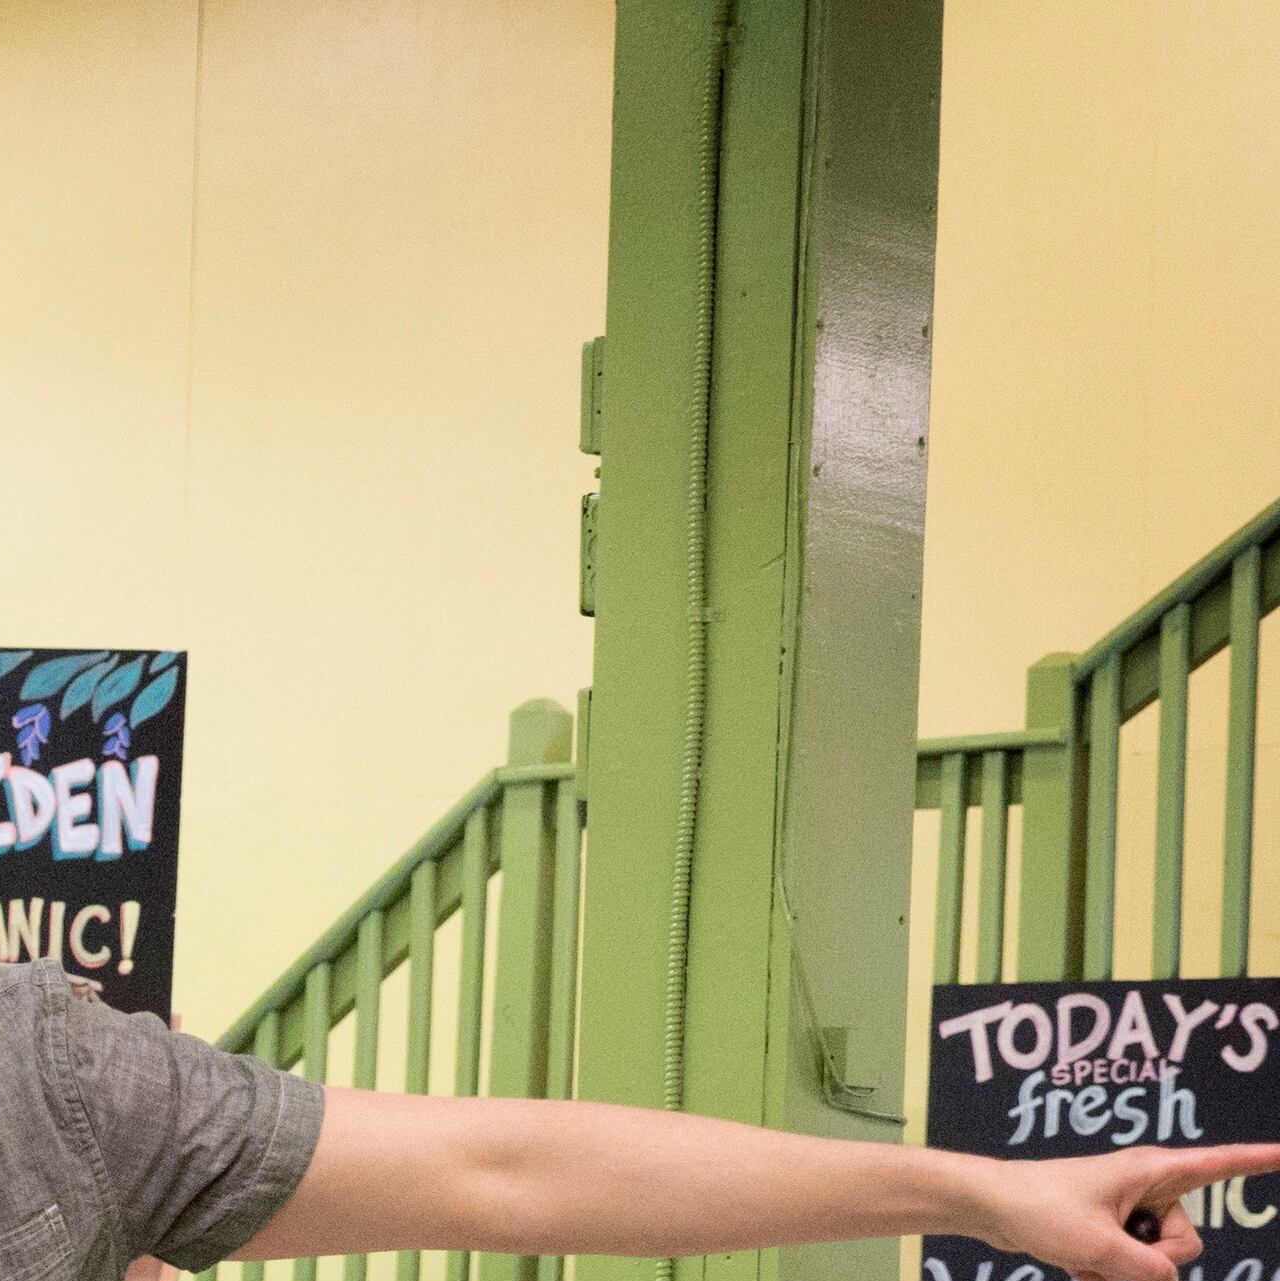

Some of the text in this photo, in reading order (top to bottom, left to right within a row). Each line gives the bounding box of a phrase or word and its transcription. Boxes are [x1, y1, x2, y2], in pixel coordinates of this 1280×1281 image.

[940, 991, 1279, 1083] TODAY'S
[1051, 1058, 1181, 1086] SPECIAL
[1008, 1067, 1204, 1146] fresh
